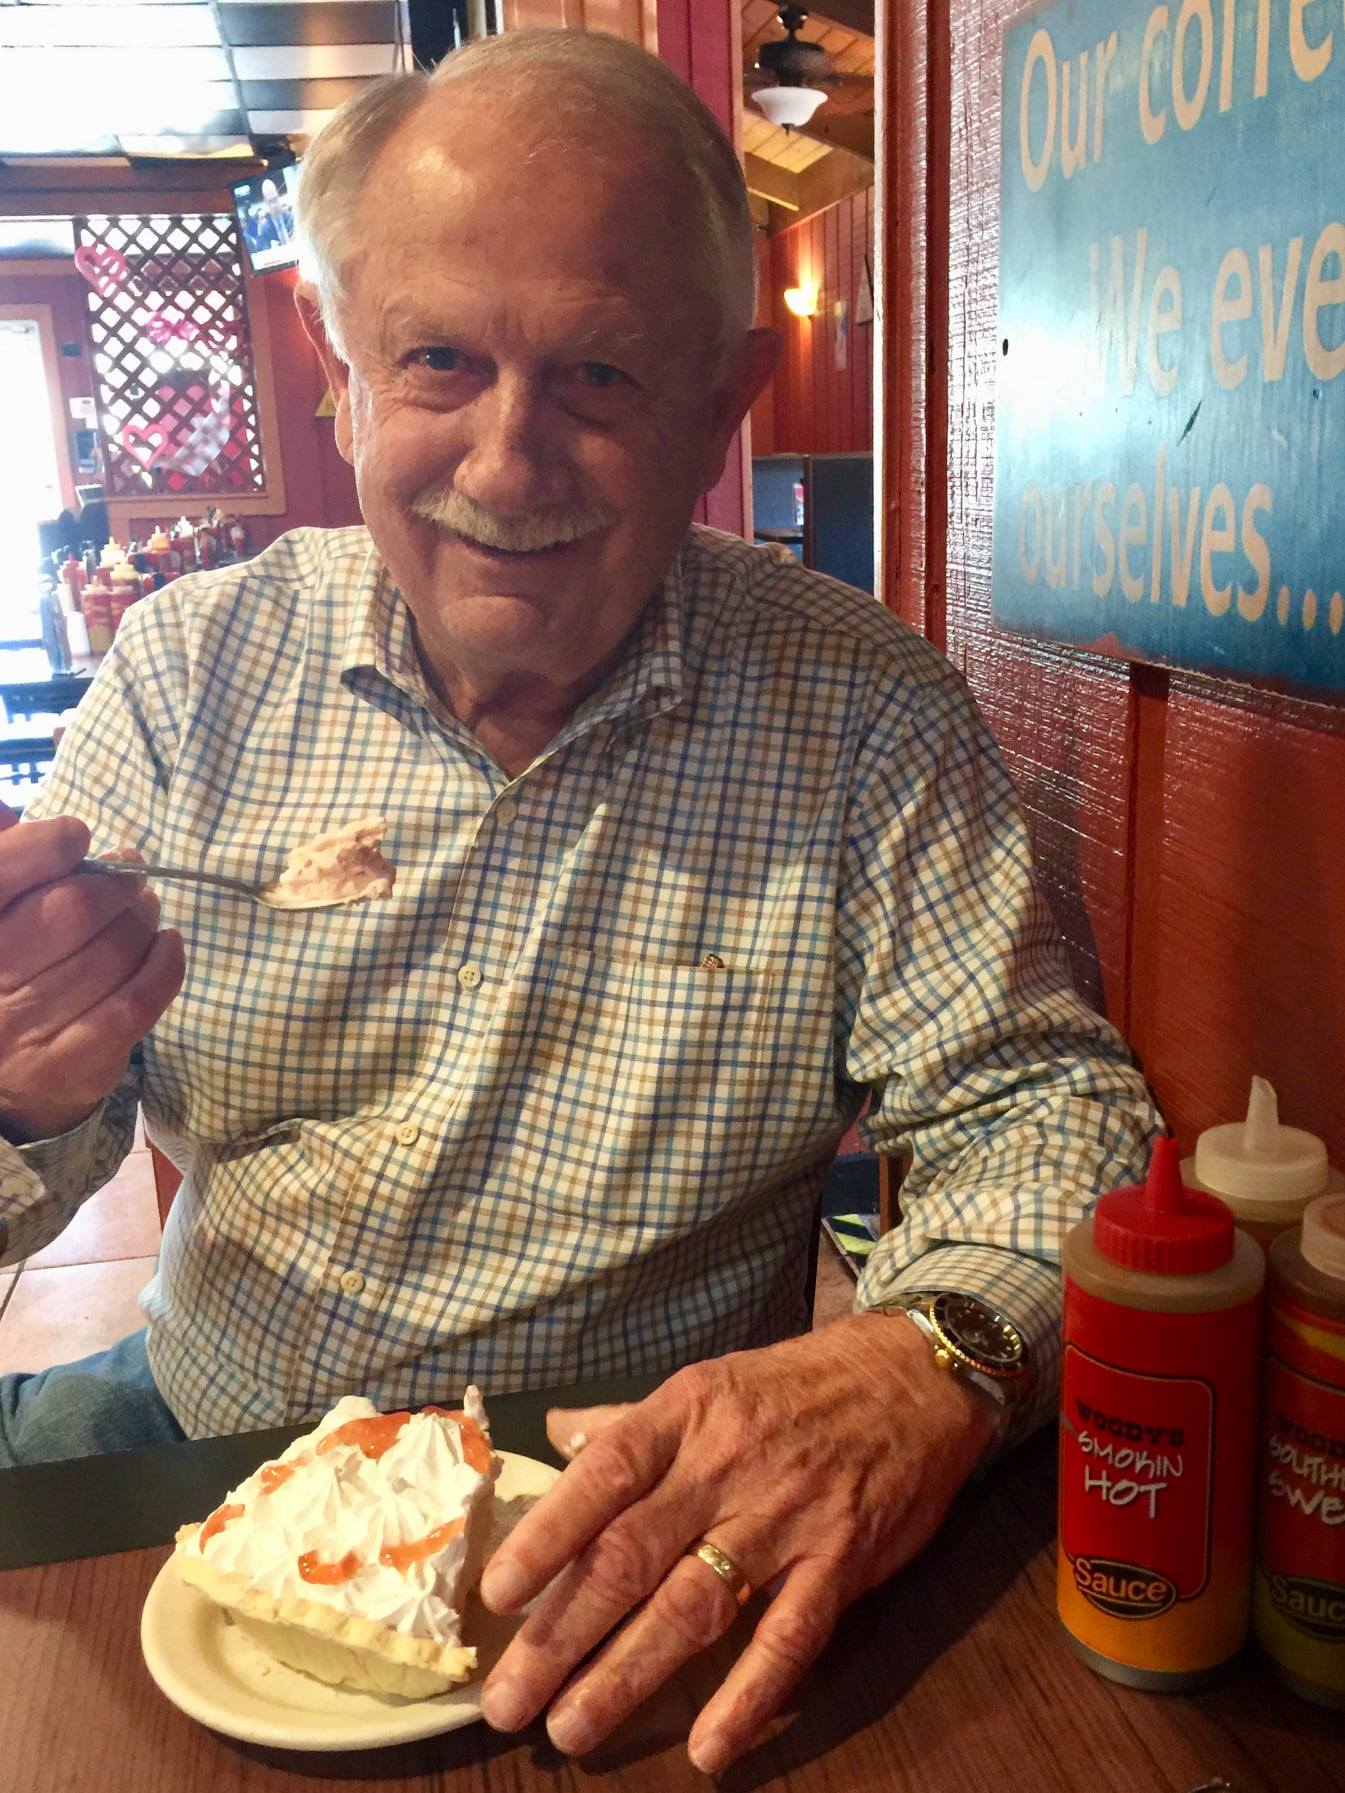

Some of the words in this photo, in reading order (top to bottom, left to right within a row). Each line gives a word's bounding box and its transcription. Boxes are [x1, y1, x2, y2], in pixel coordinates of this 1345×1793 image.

[1020, 28, 1118, 192] Our
[1088, 226, 1183, 398] We
[1077, 1430, 1184, 1479] SMOKIN
[1269, 1433, 1345, 1492] SOUTH
[1085, 1464, 1167, 1519] HOT
[1075, 1557, 1168, 1602] Sauce
